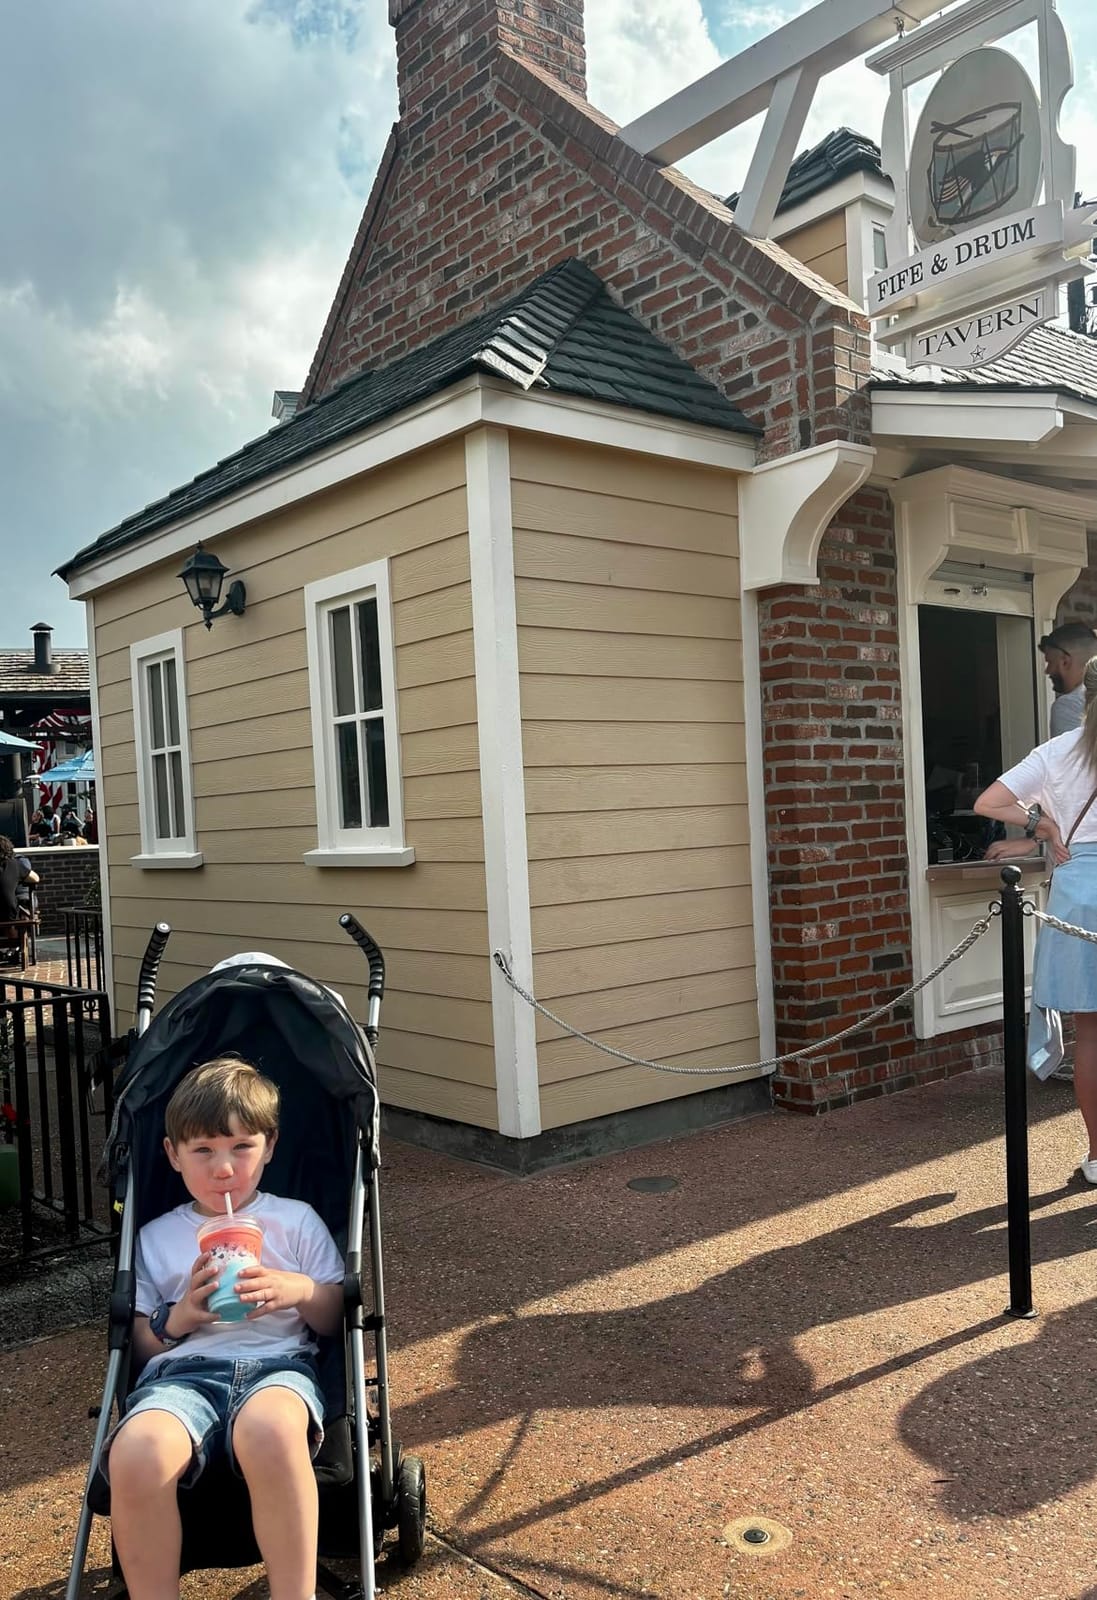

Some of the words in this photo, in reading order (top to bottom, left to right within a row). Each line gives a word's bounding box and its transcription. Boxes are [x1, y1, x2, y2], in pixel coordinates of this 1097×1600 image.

[877, 262, 924, 302] FIFE
[930, 253, 948, 275] &
[955, 217, 1036, 266] DRUM
[918, 296, 1041, 357] TAVERN
